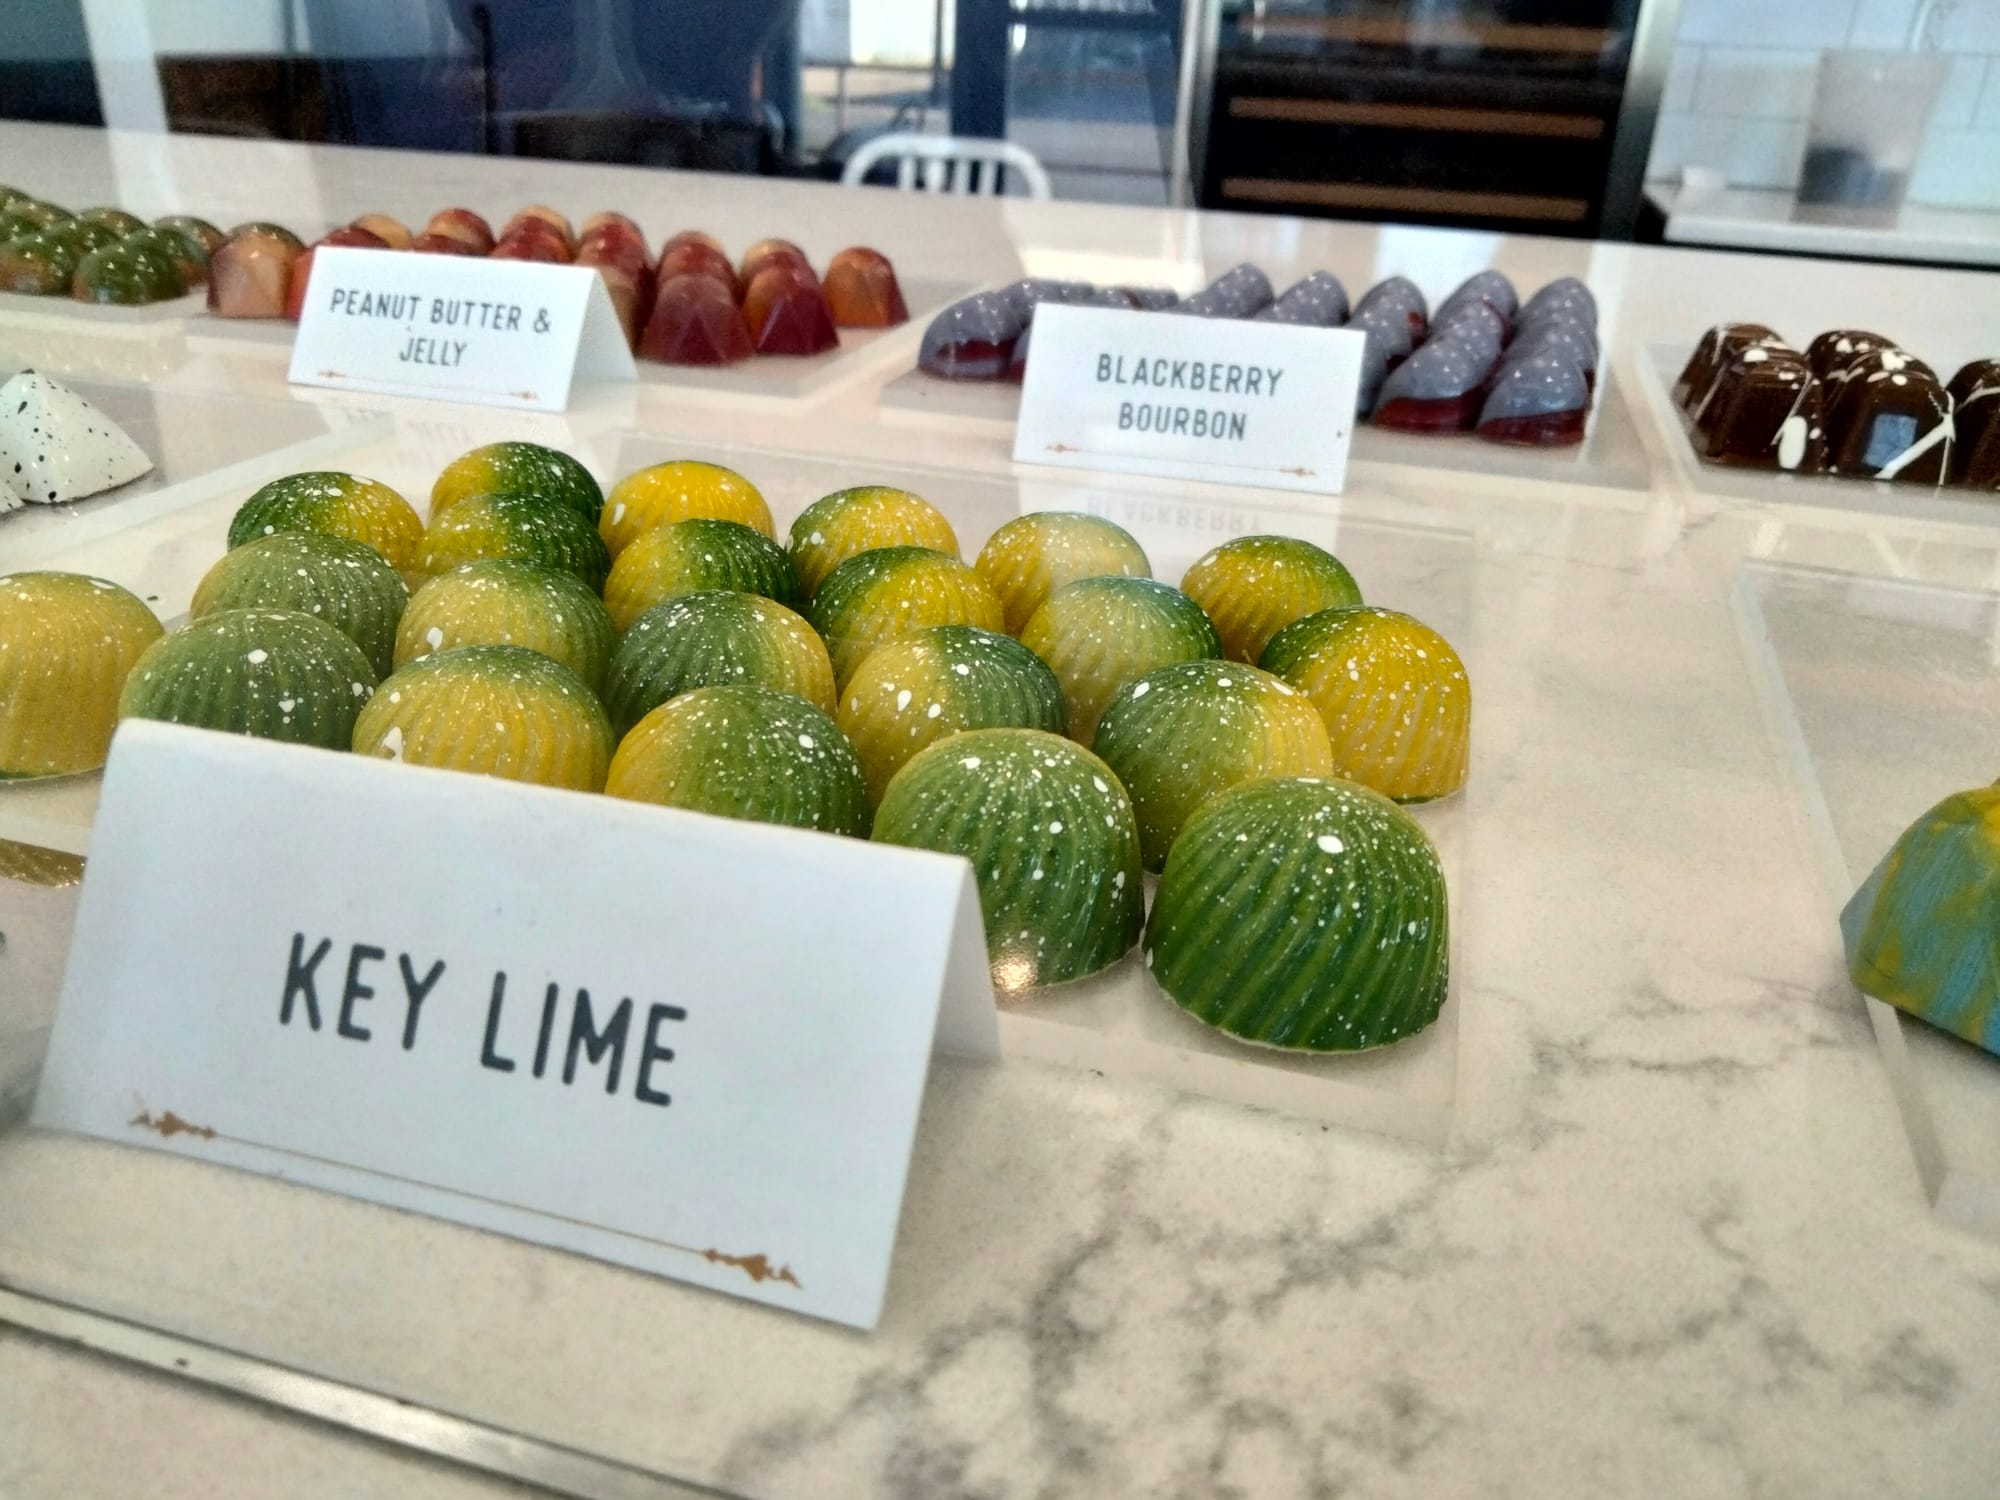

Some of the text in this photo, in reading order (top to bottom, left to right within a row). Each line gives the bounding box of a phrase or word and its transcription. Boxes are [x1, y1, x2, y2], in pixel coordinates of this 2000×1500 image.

[329, 288, 551, 334] PEANUT BUTTER &
[399, 337, 468, 367] JELLY
[1096, 353, 1284, 397] BLACKBERRY
[1118, 402, 1247, 441] BOURBON
[279, 931, 688, 1108] KEY LIME
